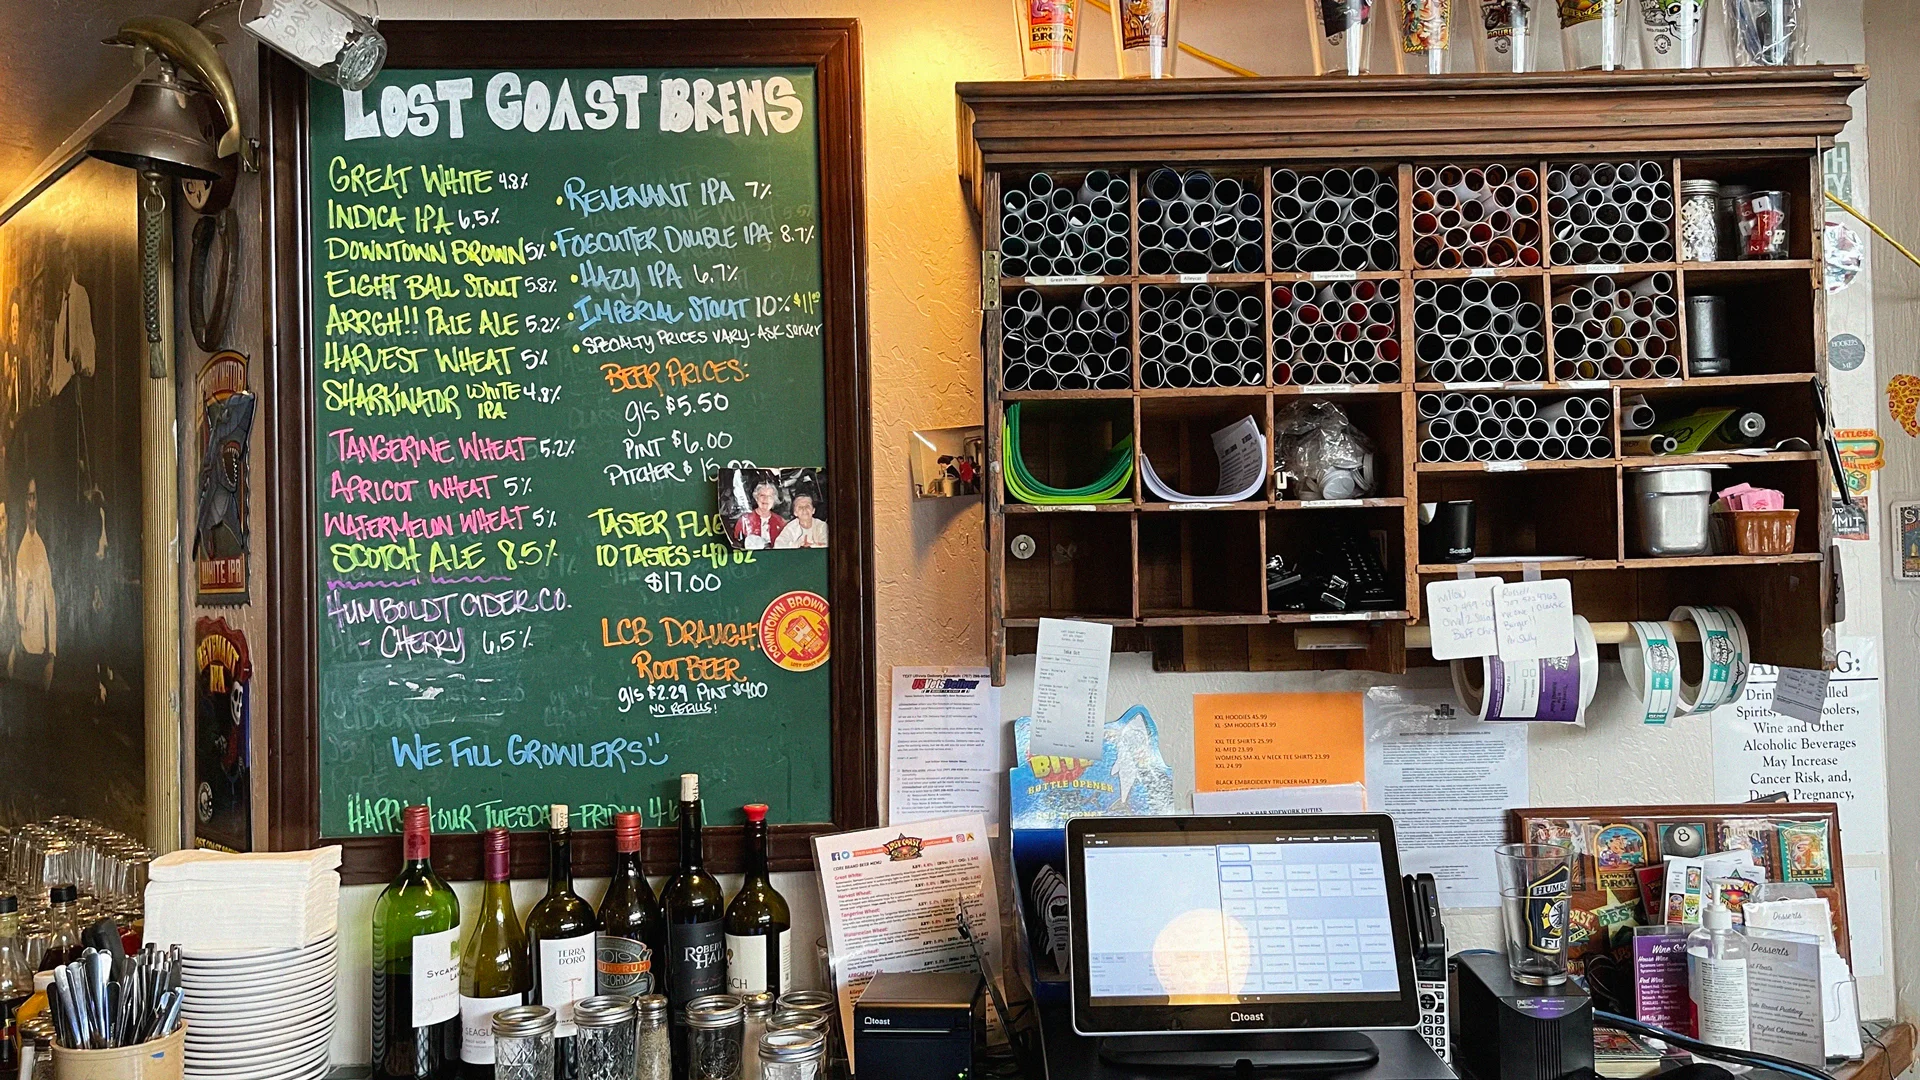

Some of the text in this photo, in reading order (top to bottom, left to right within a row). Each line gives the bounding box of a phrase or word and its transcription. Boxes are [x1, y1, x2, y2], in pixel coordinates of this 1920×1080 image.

[344, 73, 803, 141] LOST COAST BREWS
[328, 156, 528, 199] GREAT WHITE 4.8%
[564, 176, 772, 217] REVENANT IPA 7%
[328, 199, 500, 235] INDICA IPA 6.5%
[324, 237, 547, 266] DOWNTOWN BROWN 5%
[554, 221, 815, 258] FOGCUTTER DOUBLE IPA 8.7%
[324, 269, 557, 300] EIGHT BALL STOUT 5.8%
[580, 259, 740, 301] HAZY IPA 6.7%
[326, 303, 561, 337] ARRGH!! PALE ALE 5.2%
[573, 295, 791, 332] IMPERIAL STOUT 10%
[657, 328, 708, 346] PRICES
[324, 342, 548, 377] HARVEST WHEAT 5%
[600, 357, 750, 397] BEER PRICES:
[322, 378, 562, 420] SHARKINATOR 4.8%
[477, 400, 508, 420] IPA
[665, 392, 729, 417] $5.50
[328, 428, 576, 467] TANGERINE WHEAT 5.2%
[622, 429, 733, 460] PINT $6.00
[331, 470, 533, 504] APRICOT WHEAT 5%
[604, 463, 685, 486] PITCHER
[324, 505, 557, 542] WATERMELON WHEAT 5%
[588, 508, 673, 544] TASTER
[330, 538, 558, 574] SCOTCH ALE 8.5%
[596, 545, 618, 567] 10
[201, 558, 241, 585] WHITE IPA
[644, 571, 722, 593] $17.00
[327, 589, 458, 634] HUMBOLDT
[460, 589, 539, 618] CIDER
[601, 617, 654, 647] LCB
[764, 595, 827, 659] DOWNTOWN BROWN
[380, 624, 533, 664] CHERRY 6.5%
[210, 664, 226, 693] IPA
[631, 650, 747, 684] ROOT BEER
[647, 682, 731, 702] $2.29 PINT
[649, 703, 666, 714] NO
[1736, 706, 1777, 720] Spirits,
[1753, 721, 1845, 734] Wine and Other
[391, 733, 647, 774] WE FILL GROWLERS
[1743, 738, 1857, 751] Alcoholic Beverages
[1762, 755, 1838, 769] May Increase
[1028, 780, 1114, 795] BOTTLE OPENER
[1750, 770, 1852, 785] Cancer Risk, and,
[1793, 788, 1855, 802] Pregnancy,
[347, 793, 404, 835] HAPP
[902, 837, 920, 847] COAST
[1678, 829, 1690, 842] 8
[1772, 911, 1803, 921] Desserts
[558, 947, 586, 958] TERRA
[558, 955, 586, 966] D'ORO
[1652, 945, 1672, 954] Wine
[1751, 942, 1790, 957] Desserts
[872, 1017, 891, 1026] toast
[1240, 1012, 1264, 1022] toast
[1779, 1005, 1803, 1017] Pudding
